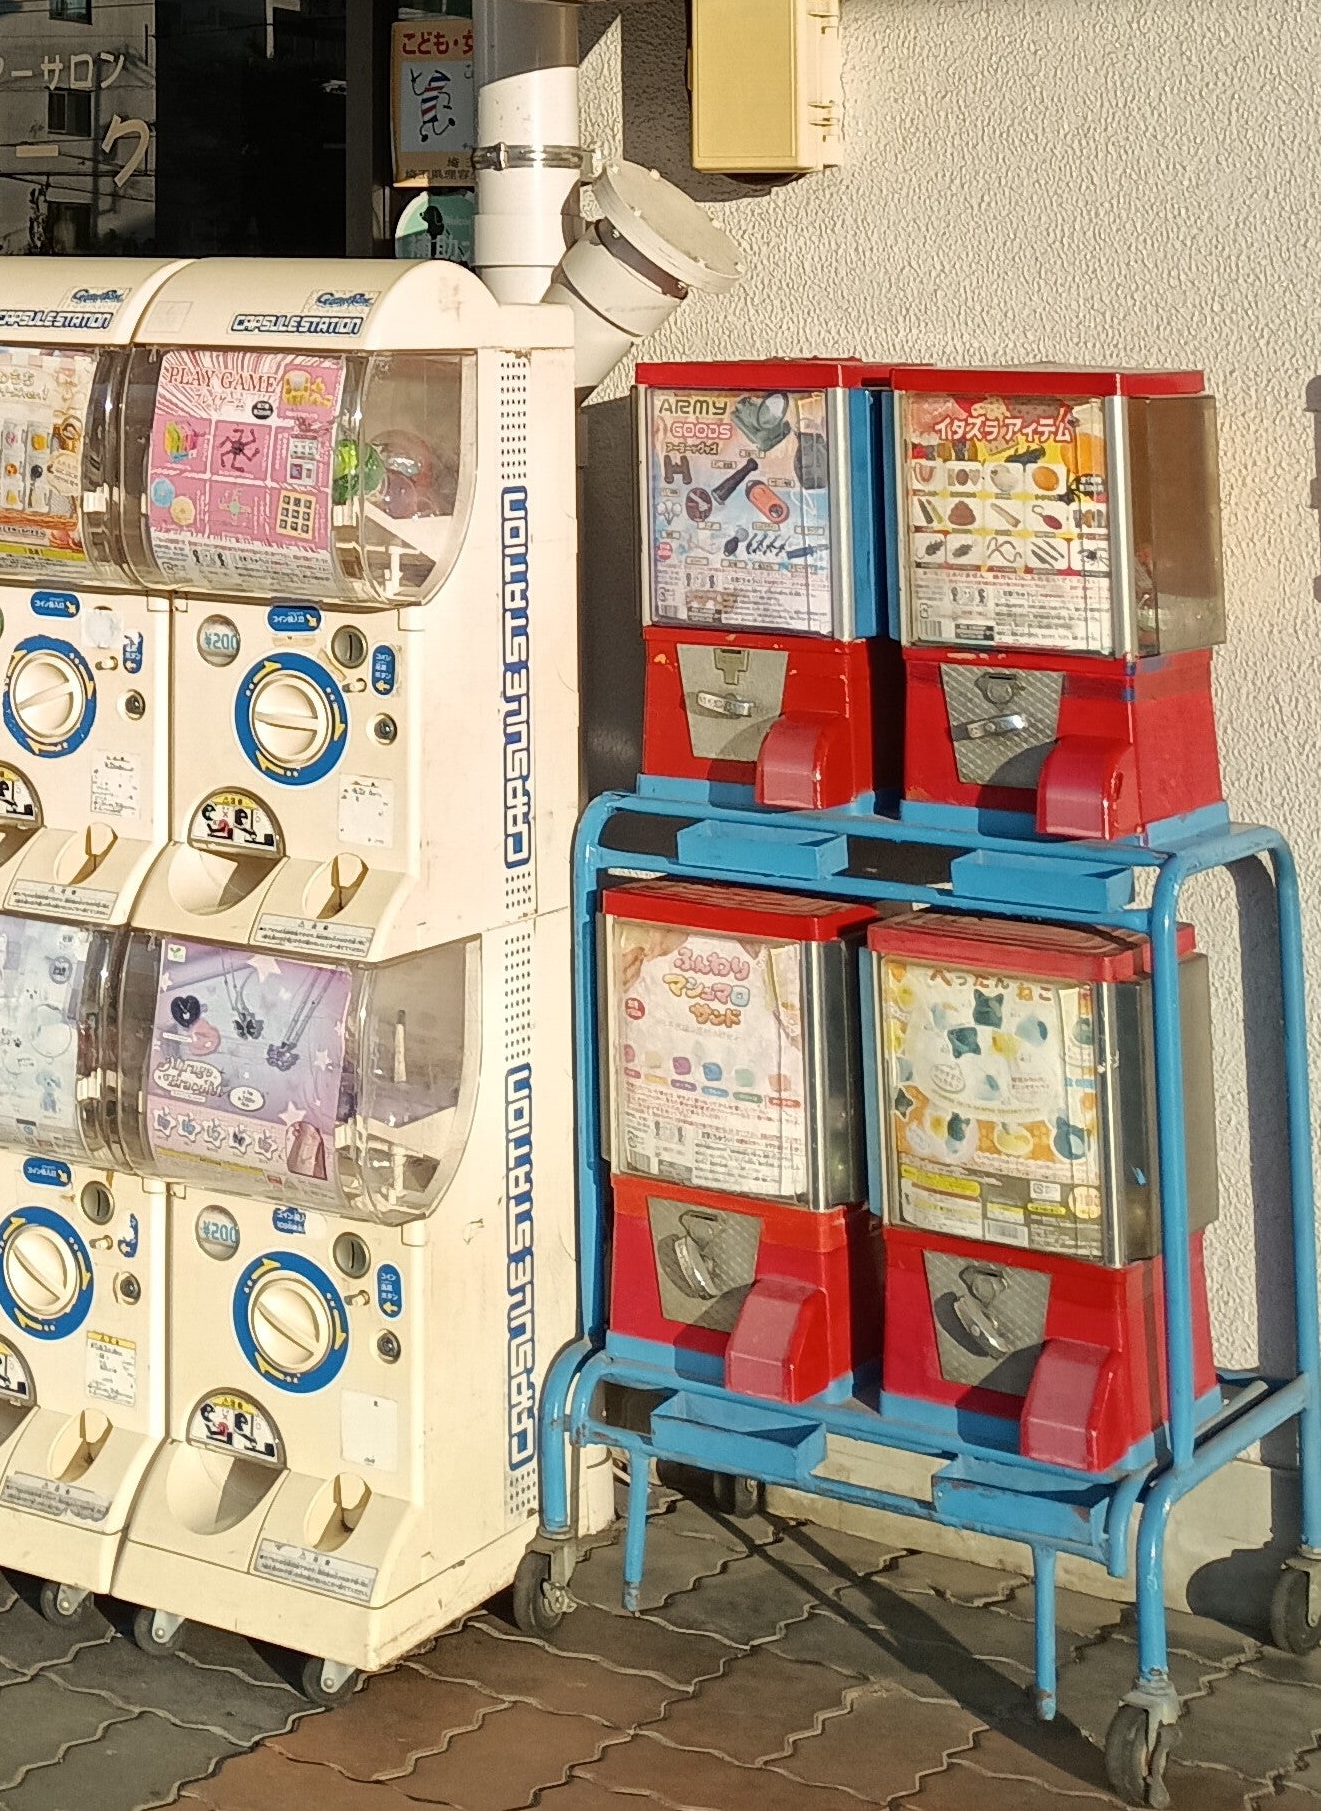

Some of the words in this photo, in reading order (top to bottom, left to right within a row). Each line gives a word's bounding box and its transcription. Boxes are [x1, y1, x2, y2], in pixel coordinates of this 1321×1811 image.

[53, 312, 113, 329] STATION
[232, 315, 300, 333] CAPSULE
[300, 316, 363, 335] STATION
[169, 366, 216, 388] PLAY
[220, 371, 278, 394] GAME
[659, 398, 728, 416] ARMY
[672, 422, 732, 440] GOODS
